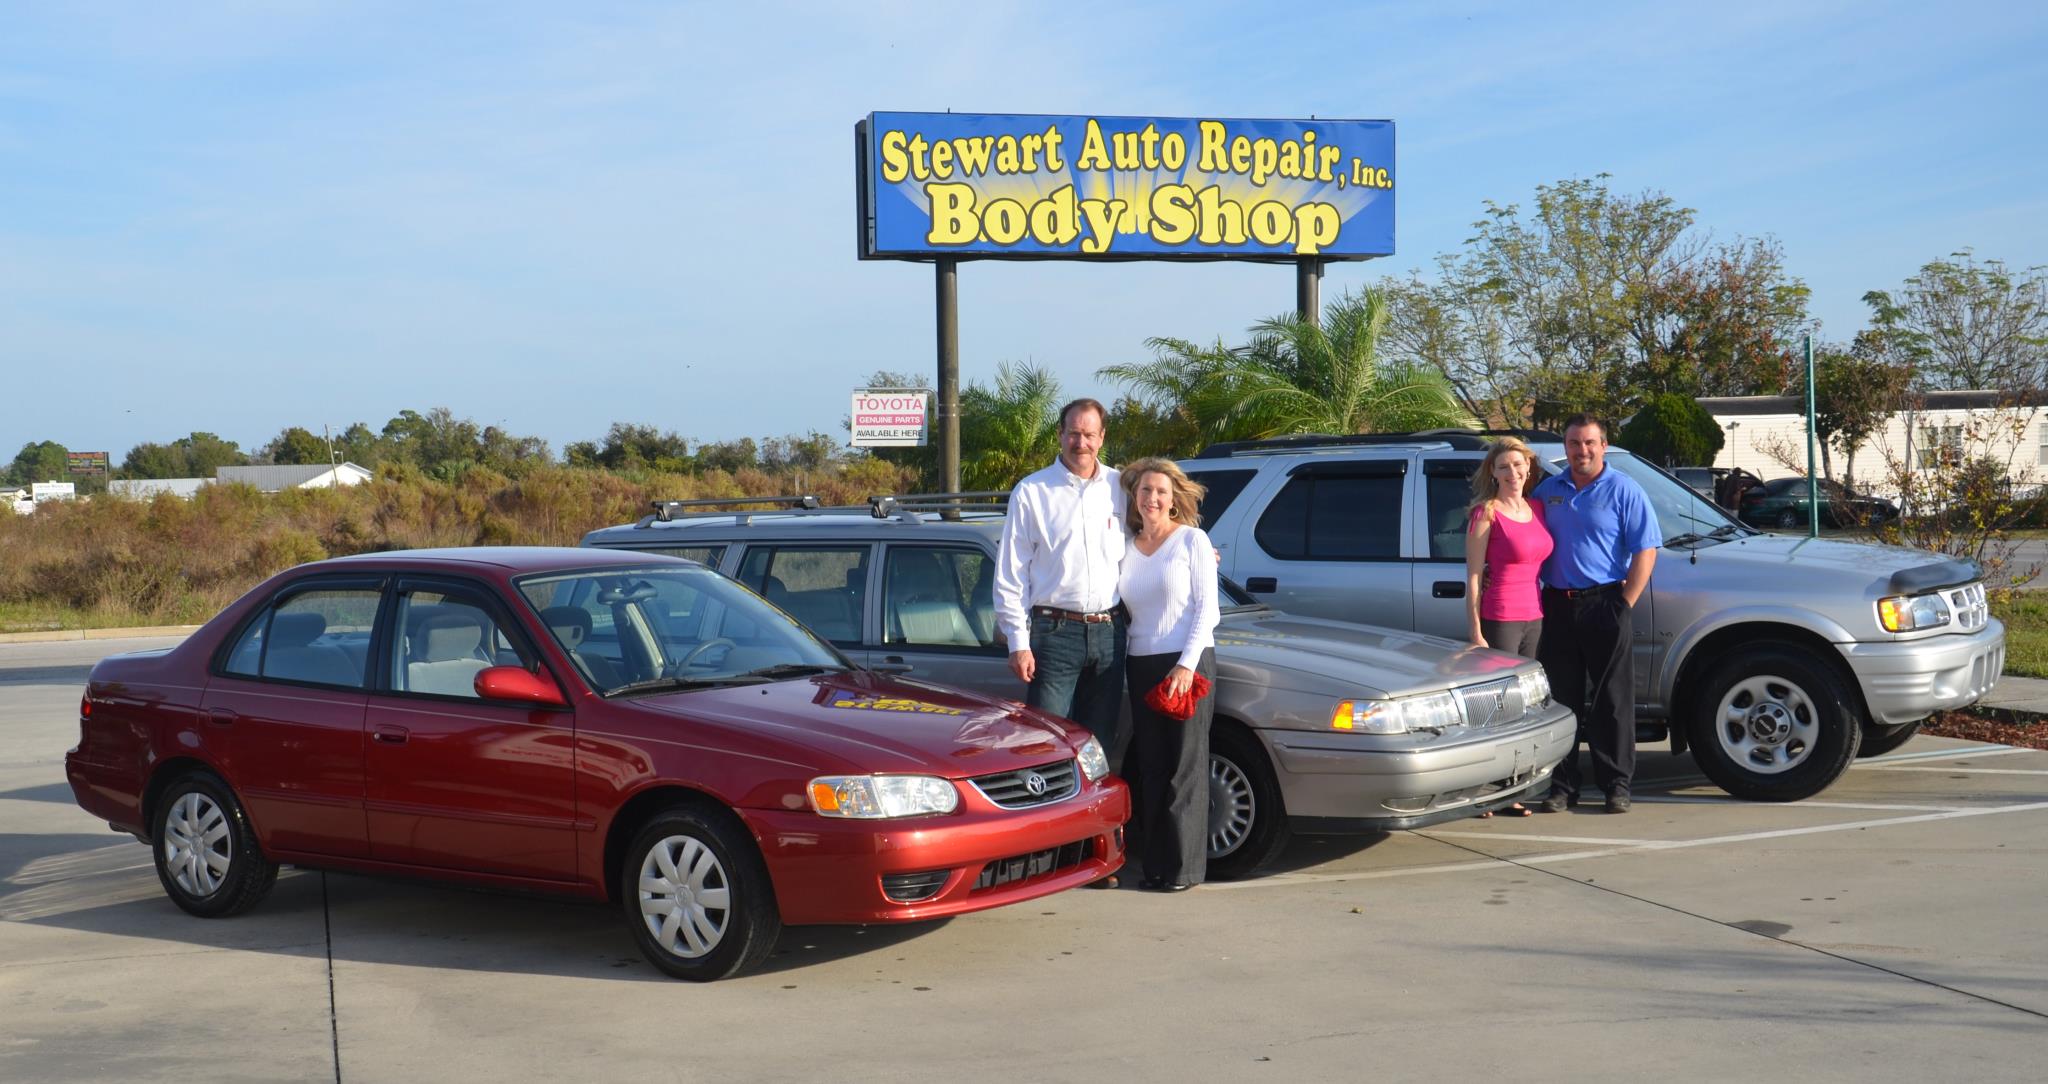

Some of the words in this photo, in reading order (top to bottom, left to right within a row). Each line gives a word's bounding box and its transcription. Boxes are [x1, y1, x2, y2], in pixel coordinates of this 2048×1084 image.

[881, 124, 1064, 185] Stewart
[1076, 117, 1188, 173] Auto
[1197, 120, 1346, 191] Repair,
[1351, 157, 1394, 190] Inc.
[923, 181, 1129, 254] Body
[1148, 182, 1342, 254] Shop
[856, 398, 923, 410] TOYOTA
[856, 429, 899, 437] AVAILABLE
[901, 429, 923, 437] HERE
